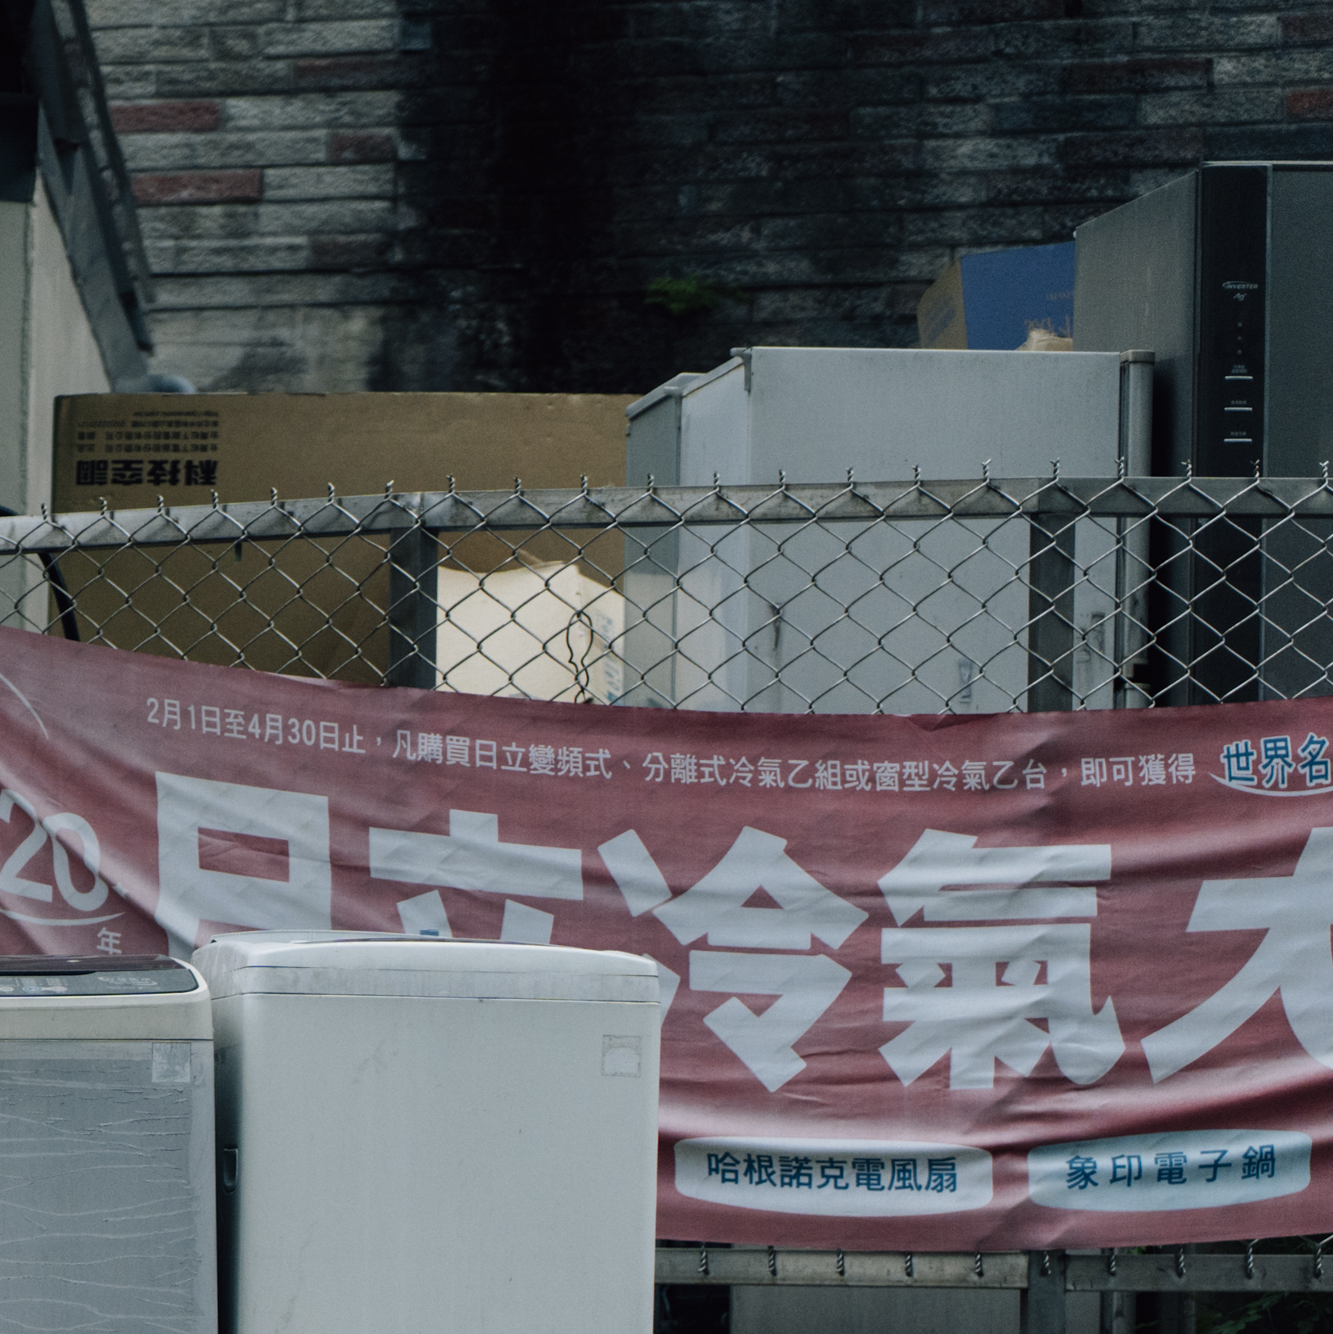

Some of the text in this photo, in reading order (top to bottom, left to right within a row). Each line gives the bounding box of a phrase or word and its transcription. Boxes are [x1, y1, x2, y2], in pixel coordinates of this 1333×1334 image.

[76, 460, 219, 486] 科技空調
[96, 927, 122, 955] 年
[706, 1152, 958, 1193] 哈根諾克電風扇
[1066, 1145, 1276, 1190] 象印電子鍋
